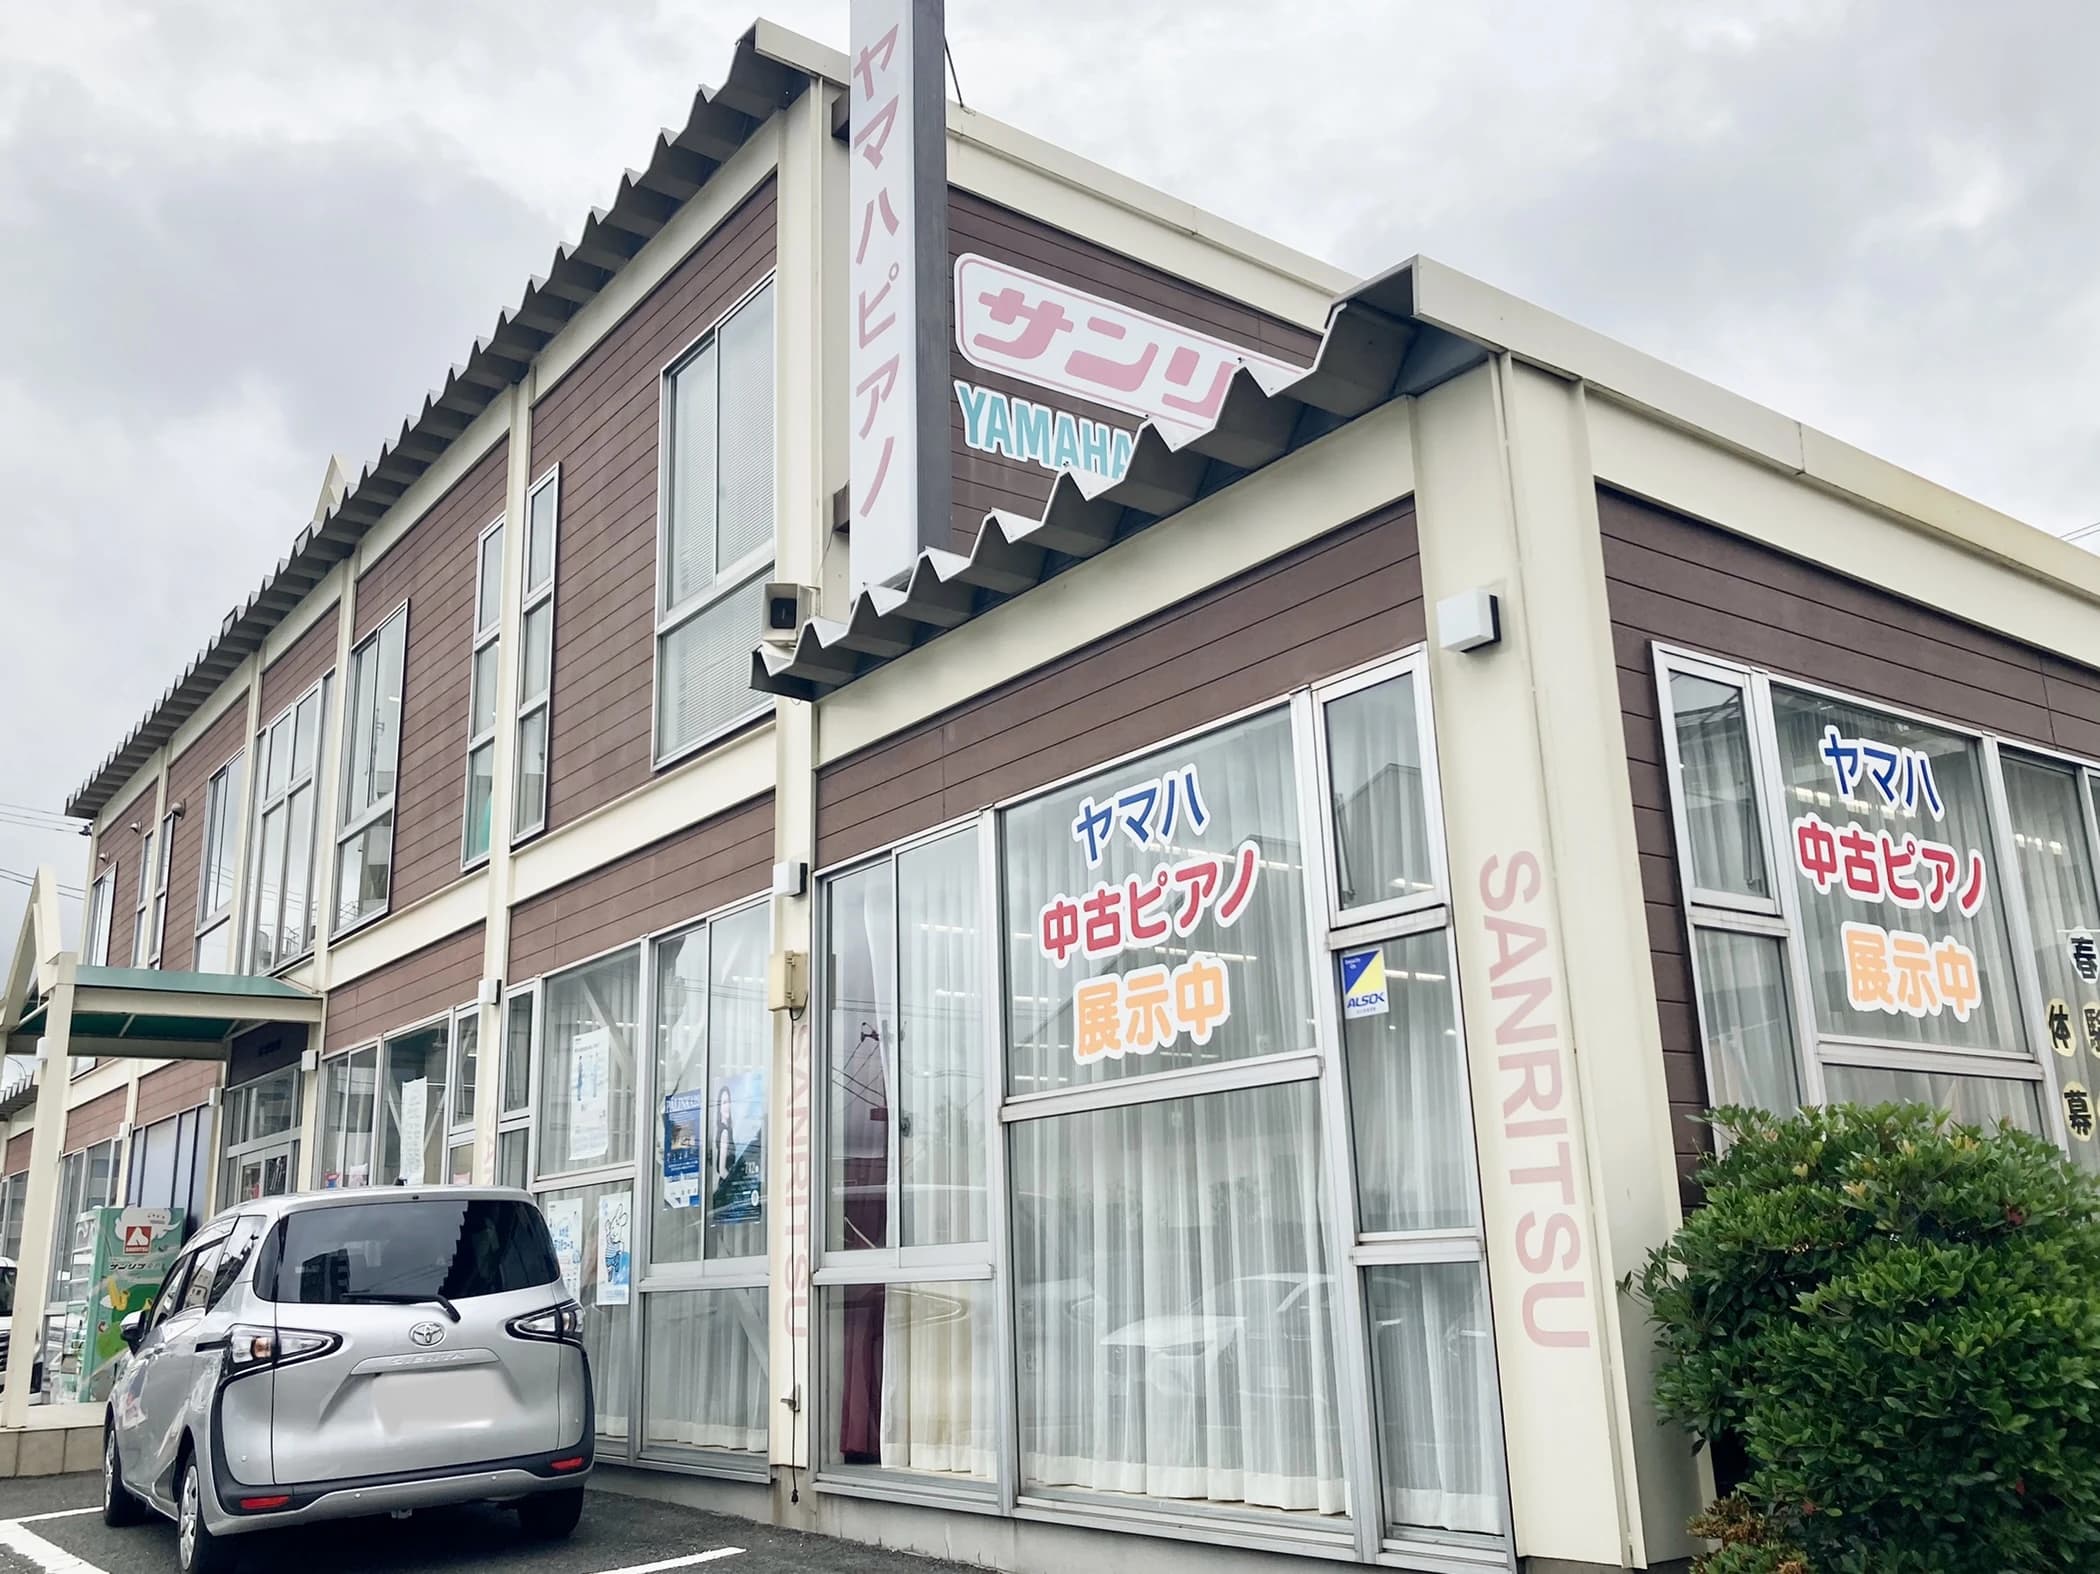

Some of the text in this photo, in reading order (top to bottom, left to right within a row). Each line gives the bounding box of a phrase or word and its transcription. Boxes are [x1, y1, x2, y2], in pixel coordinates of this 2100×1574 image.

[853, 23, 900, 518] ヤマハピアノ
[958, 385, 1134, 480] YAMAHA
[1076, 772, 1205, 861] ヤマハ
[1824, 733, 1940, 814] ヤマハ
[1043, 848, 1255, 961] 中古ピアノ
[1797, 821, 1982, 910] 中古ピアノ
[1077, 961, 1226, 1057] 展示中
[1346, 992, 1385, 1009] ALSOK
[1845, 928, 1978, 1015] 展示中
[1479, 849, 1590, 1349] SANRITSU
[785, 1024, 809, 1338] SANRITSU
